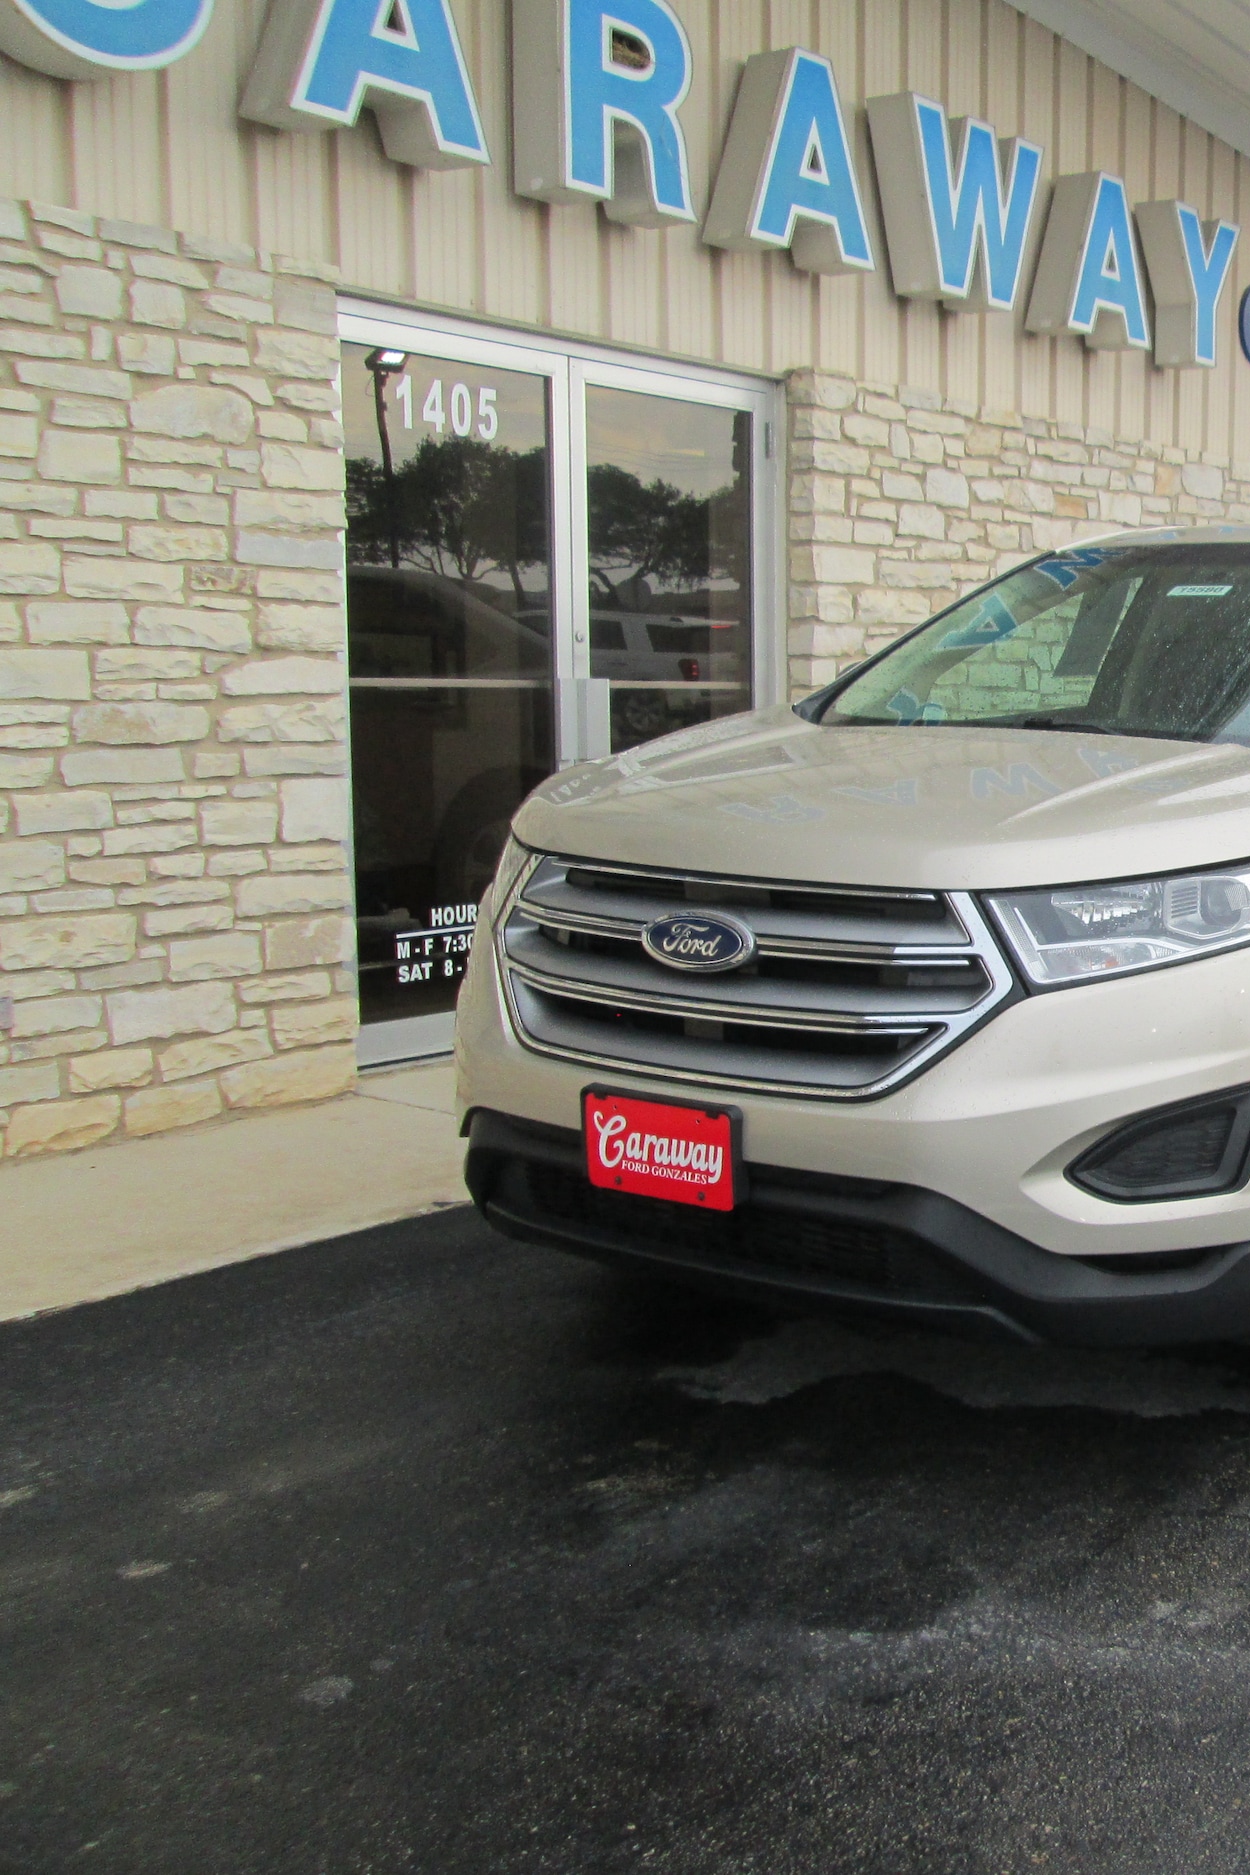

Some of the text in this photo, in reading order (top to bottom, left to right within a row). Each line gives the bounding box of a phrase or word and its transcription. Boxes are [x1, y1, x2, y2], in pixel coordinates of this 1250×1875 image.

[0, 0, 1239, 368] ARAWAY
[395, 374, 499, 440] 1405
[662, 922, 722, 957] Ford
[397, 962, 433, 983] SAT
[593, 1111, 723, 1184] Caraway
[621, 1160, 708, 1185] FORD GONZALES
